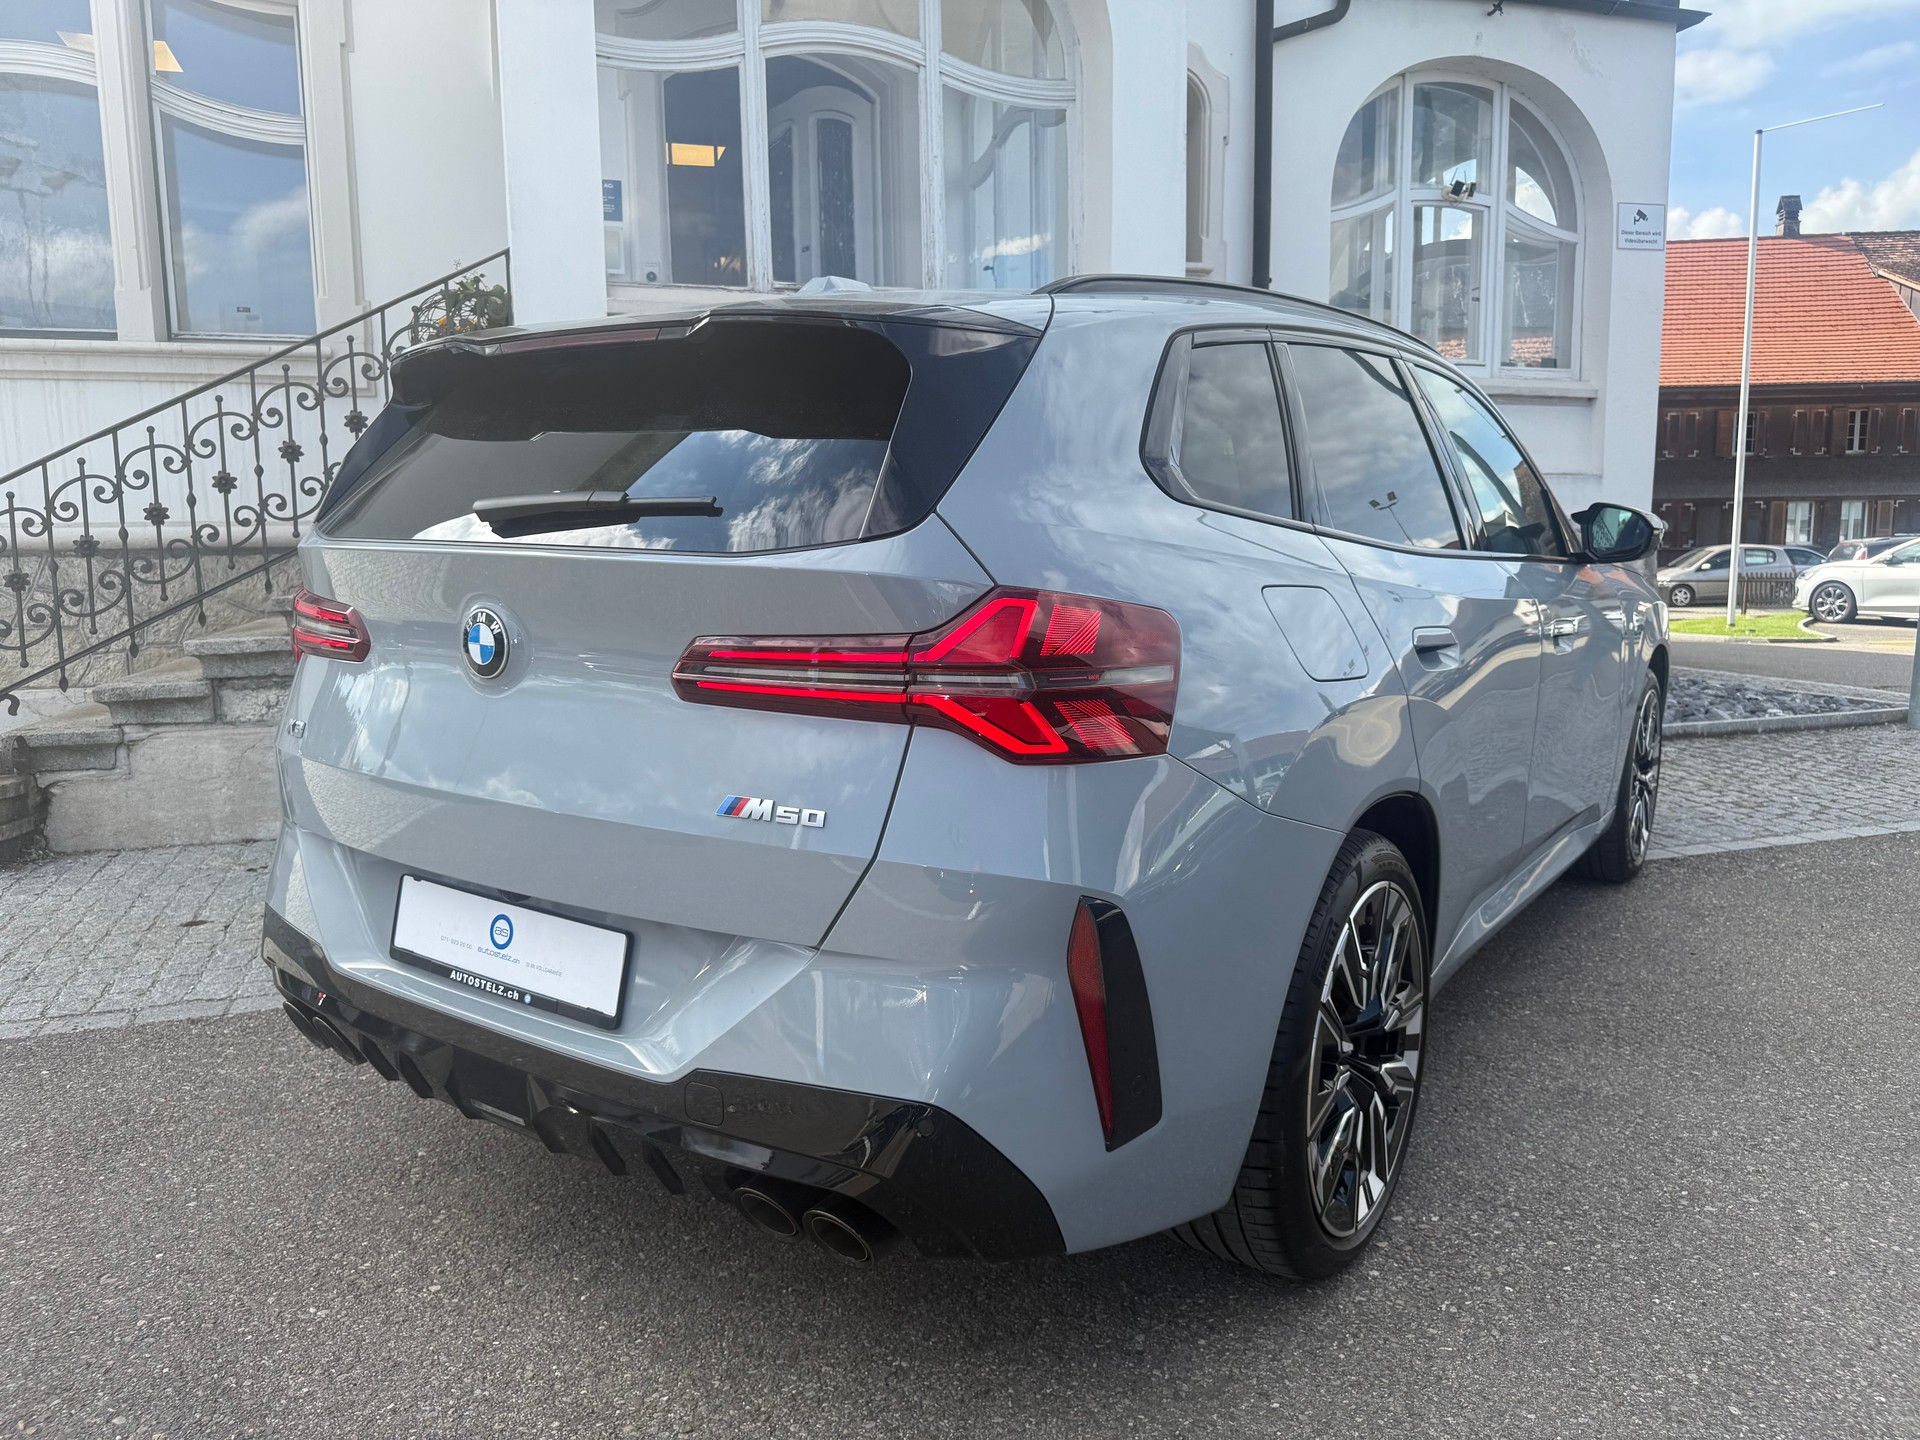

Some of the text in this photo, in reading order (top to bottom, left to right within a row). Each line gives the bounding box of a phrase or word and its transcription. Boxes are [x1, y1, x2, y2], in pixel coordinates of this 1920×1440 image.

[465, 612, 502, 635] BMW
[738, 797, 826, 828] M50
[477, 946, 520, 964] autostelz.ch
[450, 970, 519, 1000] AUTOSTELZ.ch
